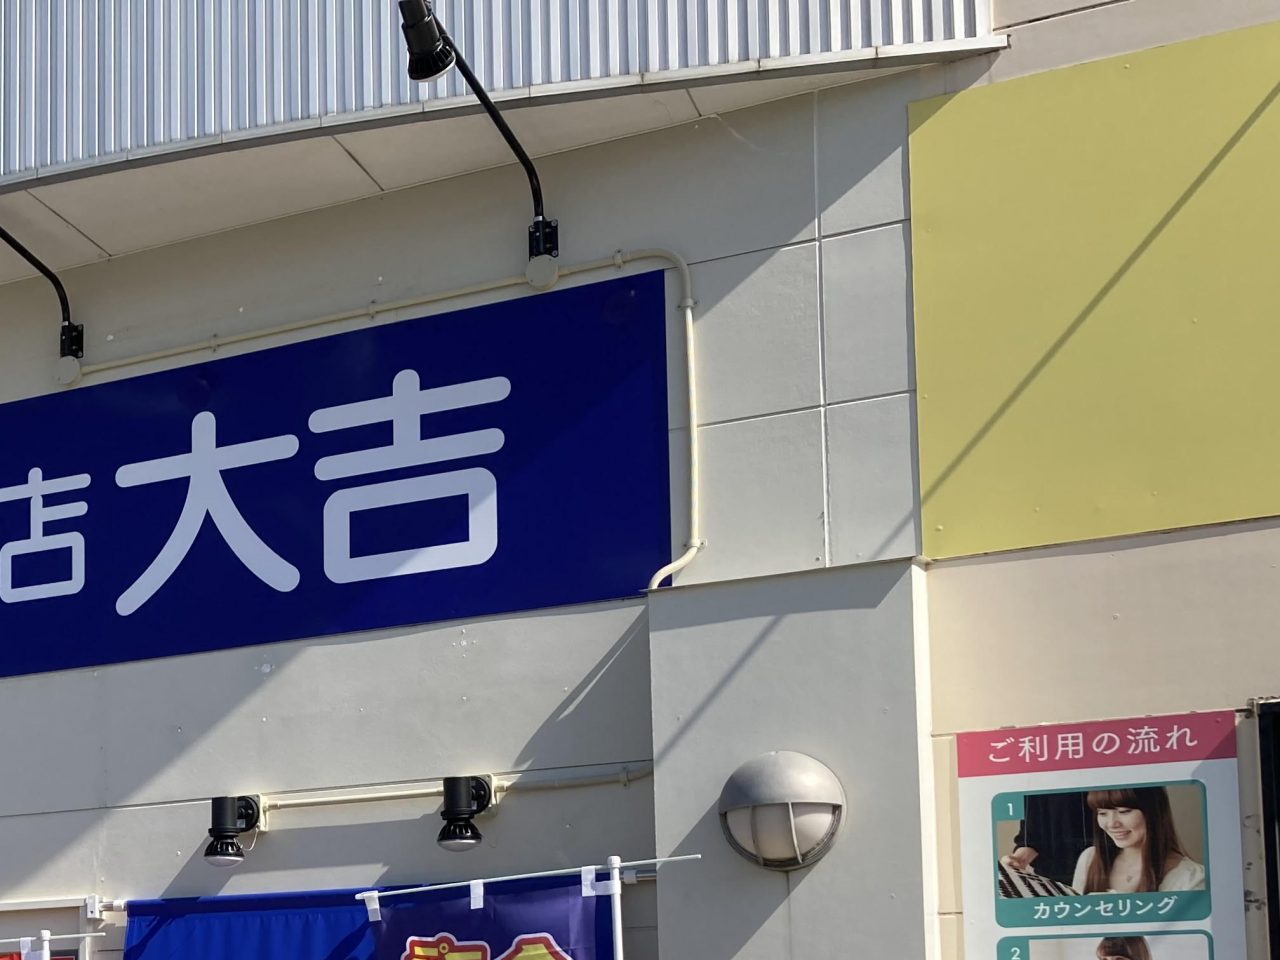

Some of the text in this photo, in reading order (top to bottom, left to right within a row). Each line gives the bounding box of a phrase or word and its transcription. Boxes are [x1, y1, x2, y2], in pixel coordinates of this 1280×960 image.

[115, 368, 512, 617] 大吉
[988, 725, 1198, 763] ご利用の流れ
[1007, 802, 1014, 817] 1
[1032, 895, 1178, 921] カウンセリング
[1010, 947, 1021, 960] 2
